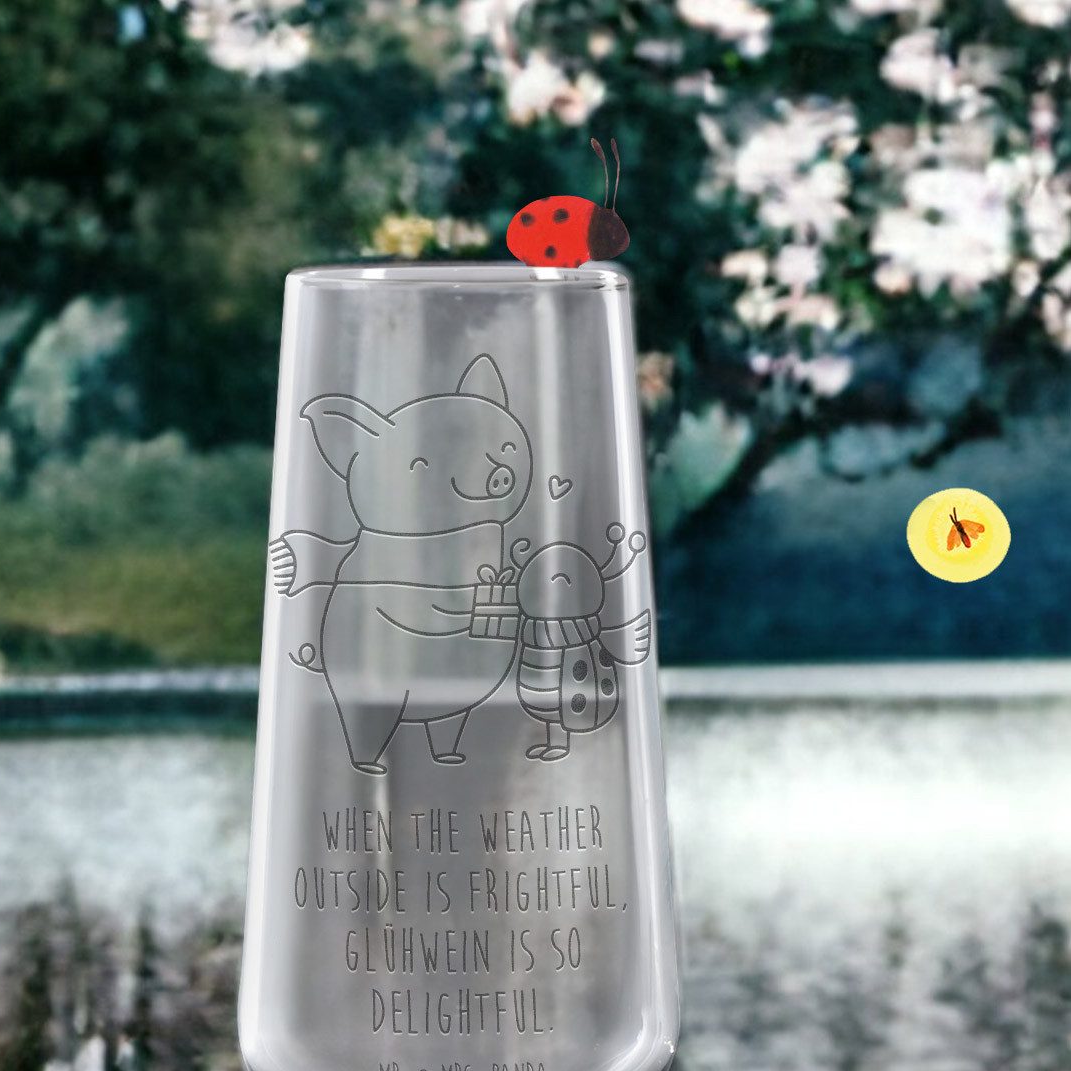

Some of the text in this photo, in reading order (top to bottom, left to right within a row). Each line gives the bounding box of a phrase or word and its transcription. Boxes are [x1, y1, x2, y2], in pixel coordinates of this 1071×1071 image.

[323, 805, 603, 854] WHEN THE WEATHER
[294, 865, 627, 914] OUTSIDE IS FRIGHTFUL,
[346, 924, 581, 974] GLÜHWEIN IS SO
[372, 988, 554, 1035] DELIGHTFUL.
